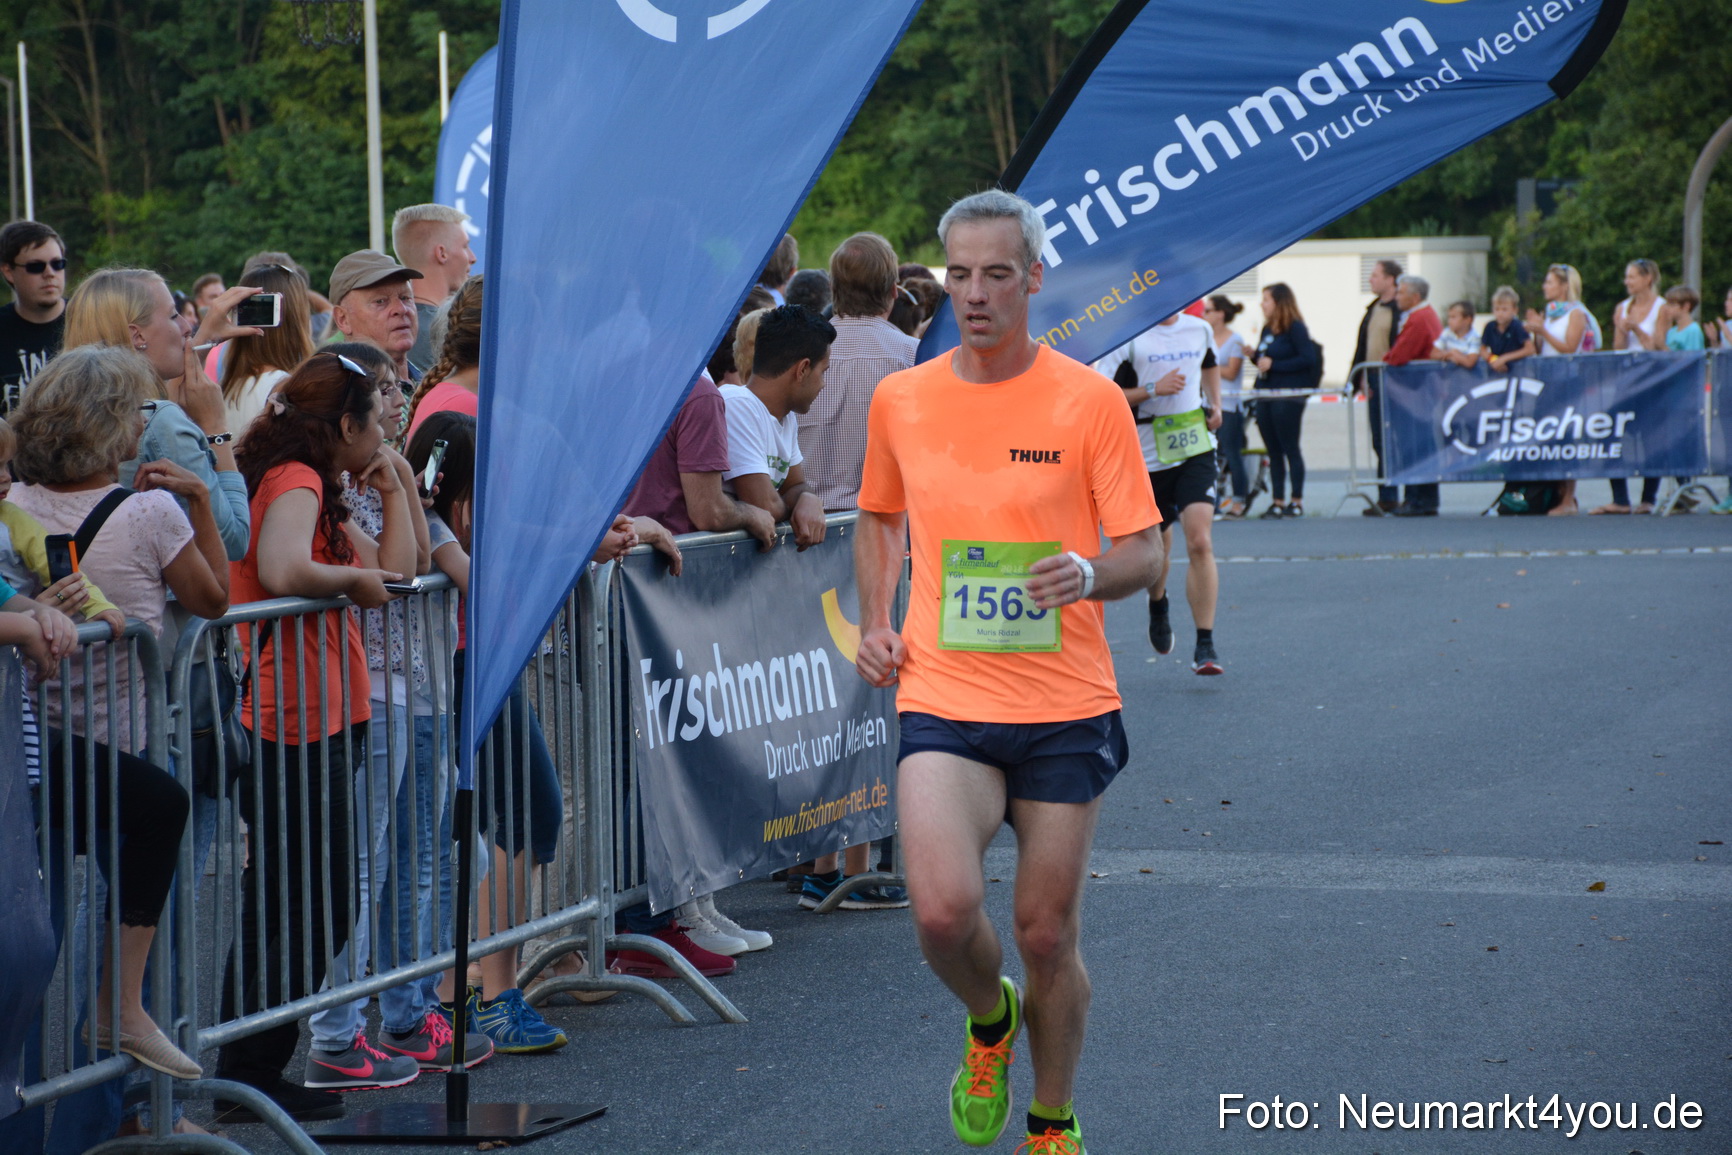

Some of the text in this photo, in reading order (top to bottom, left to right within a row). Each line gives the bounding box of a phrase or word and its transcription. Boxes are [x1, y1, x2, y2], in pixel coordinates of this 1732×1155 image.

[1290, 92, 1392, 162] Druck
[1394, 57, 1462, 103] und
[1036, 16, 1439, 269] Frischmann
[1167, 429, 1199, 450] 285
[1476, 406, 1635, 445] Fischer
[1009, 448, 1062, 464] THULE
[1486, 443, 1623, 462] AUTOMOBILE
[959, 557, 1000, 569] firmenlauf
[976, 628, 997, 636] Muris
[640, 643, 838, 750] Frischmann
[764, 710, 887, 780] Druck und Medien
[763, 777, 888, 843] www.frischmann-net.de
